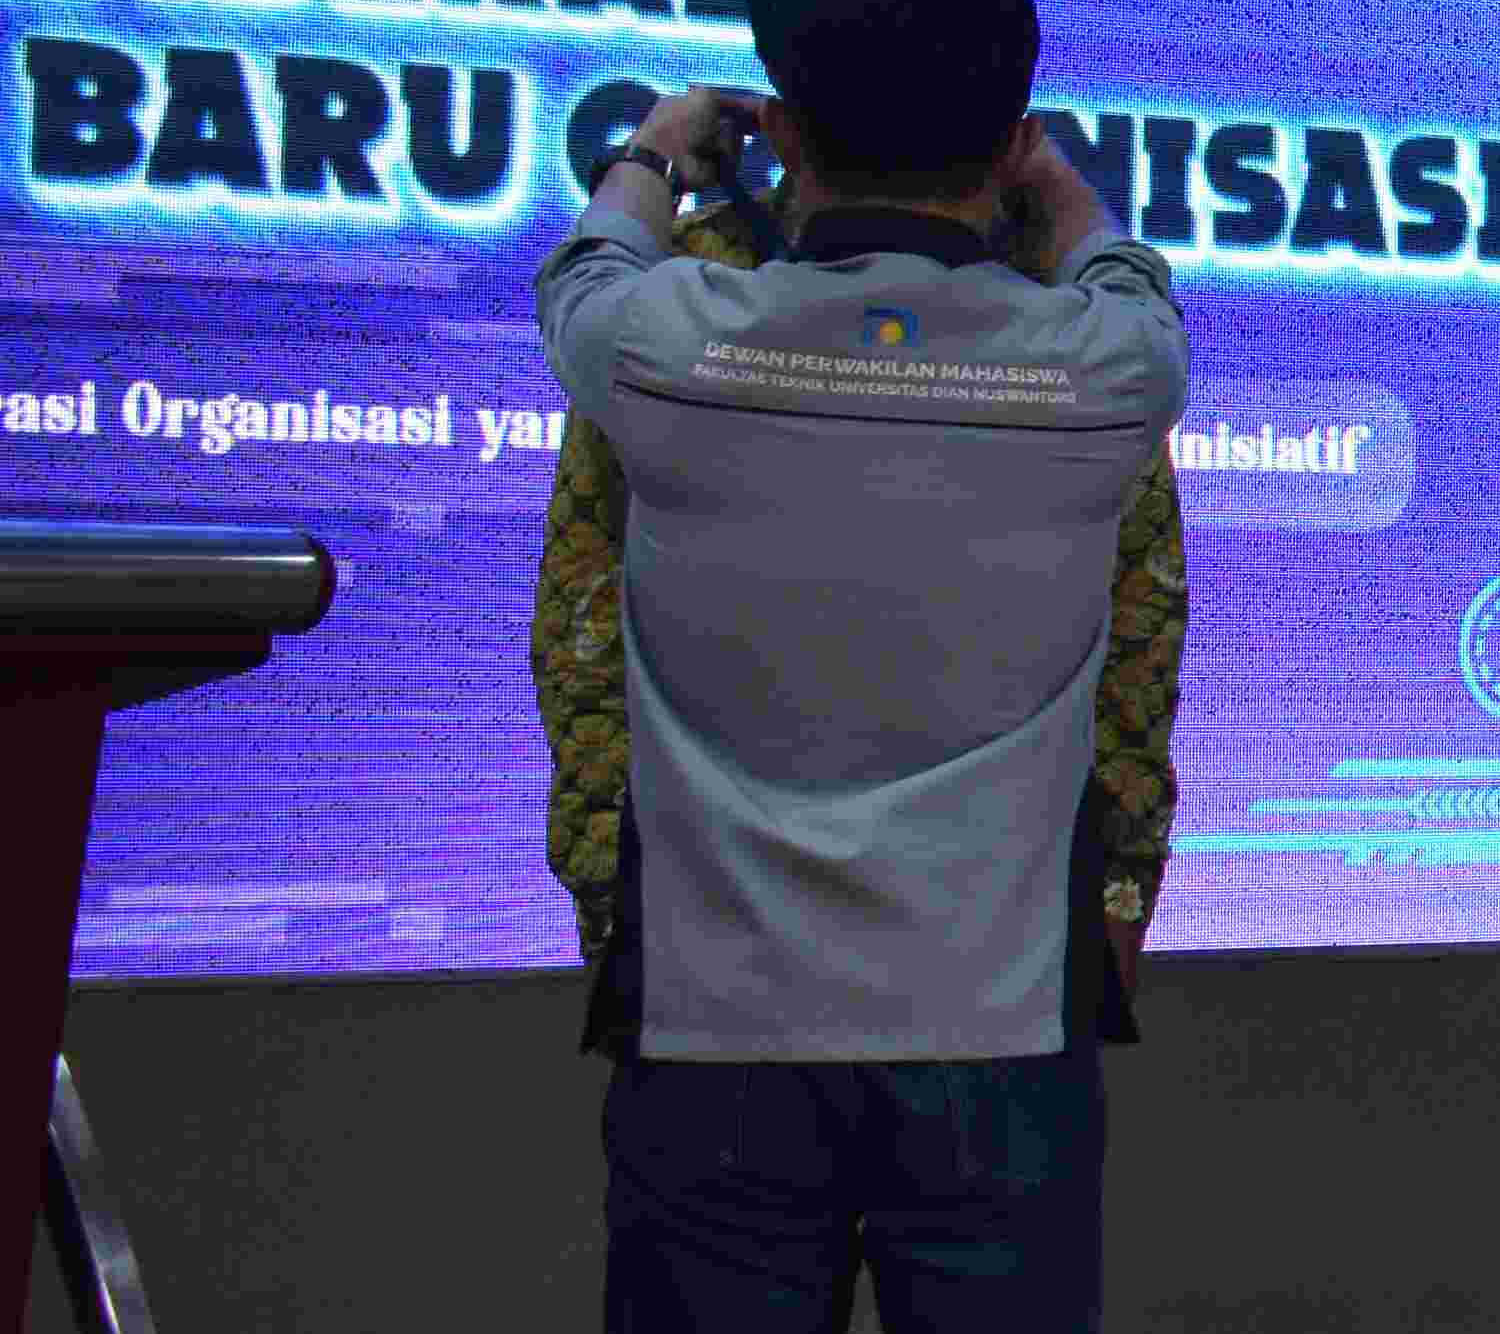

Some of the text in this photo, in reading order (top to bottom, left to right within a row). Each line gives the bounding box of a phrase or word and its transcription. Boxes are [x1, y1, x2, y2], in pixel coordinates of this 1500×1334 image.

[25, 38, 515, 204] BARU
[703, 341, 1072, 387] DEWAN PERWAKILAN MAHASISWA
[932, 385, 970, 401] DIAN
[122, 379, 456, 455] Organisasi
